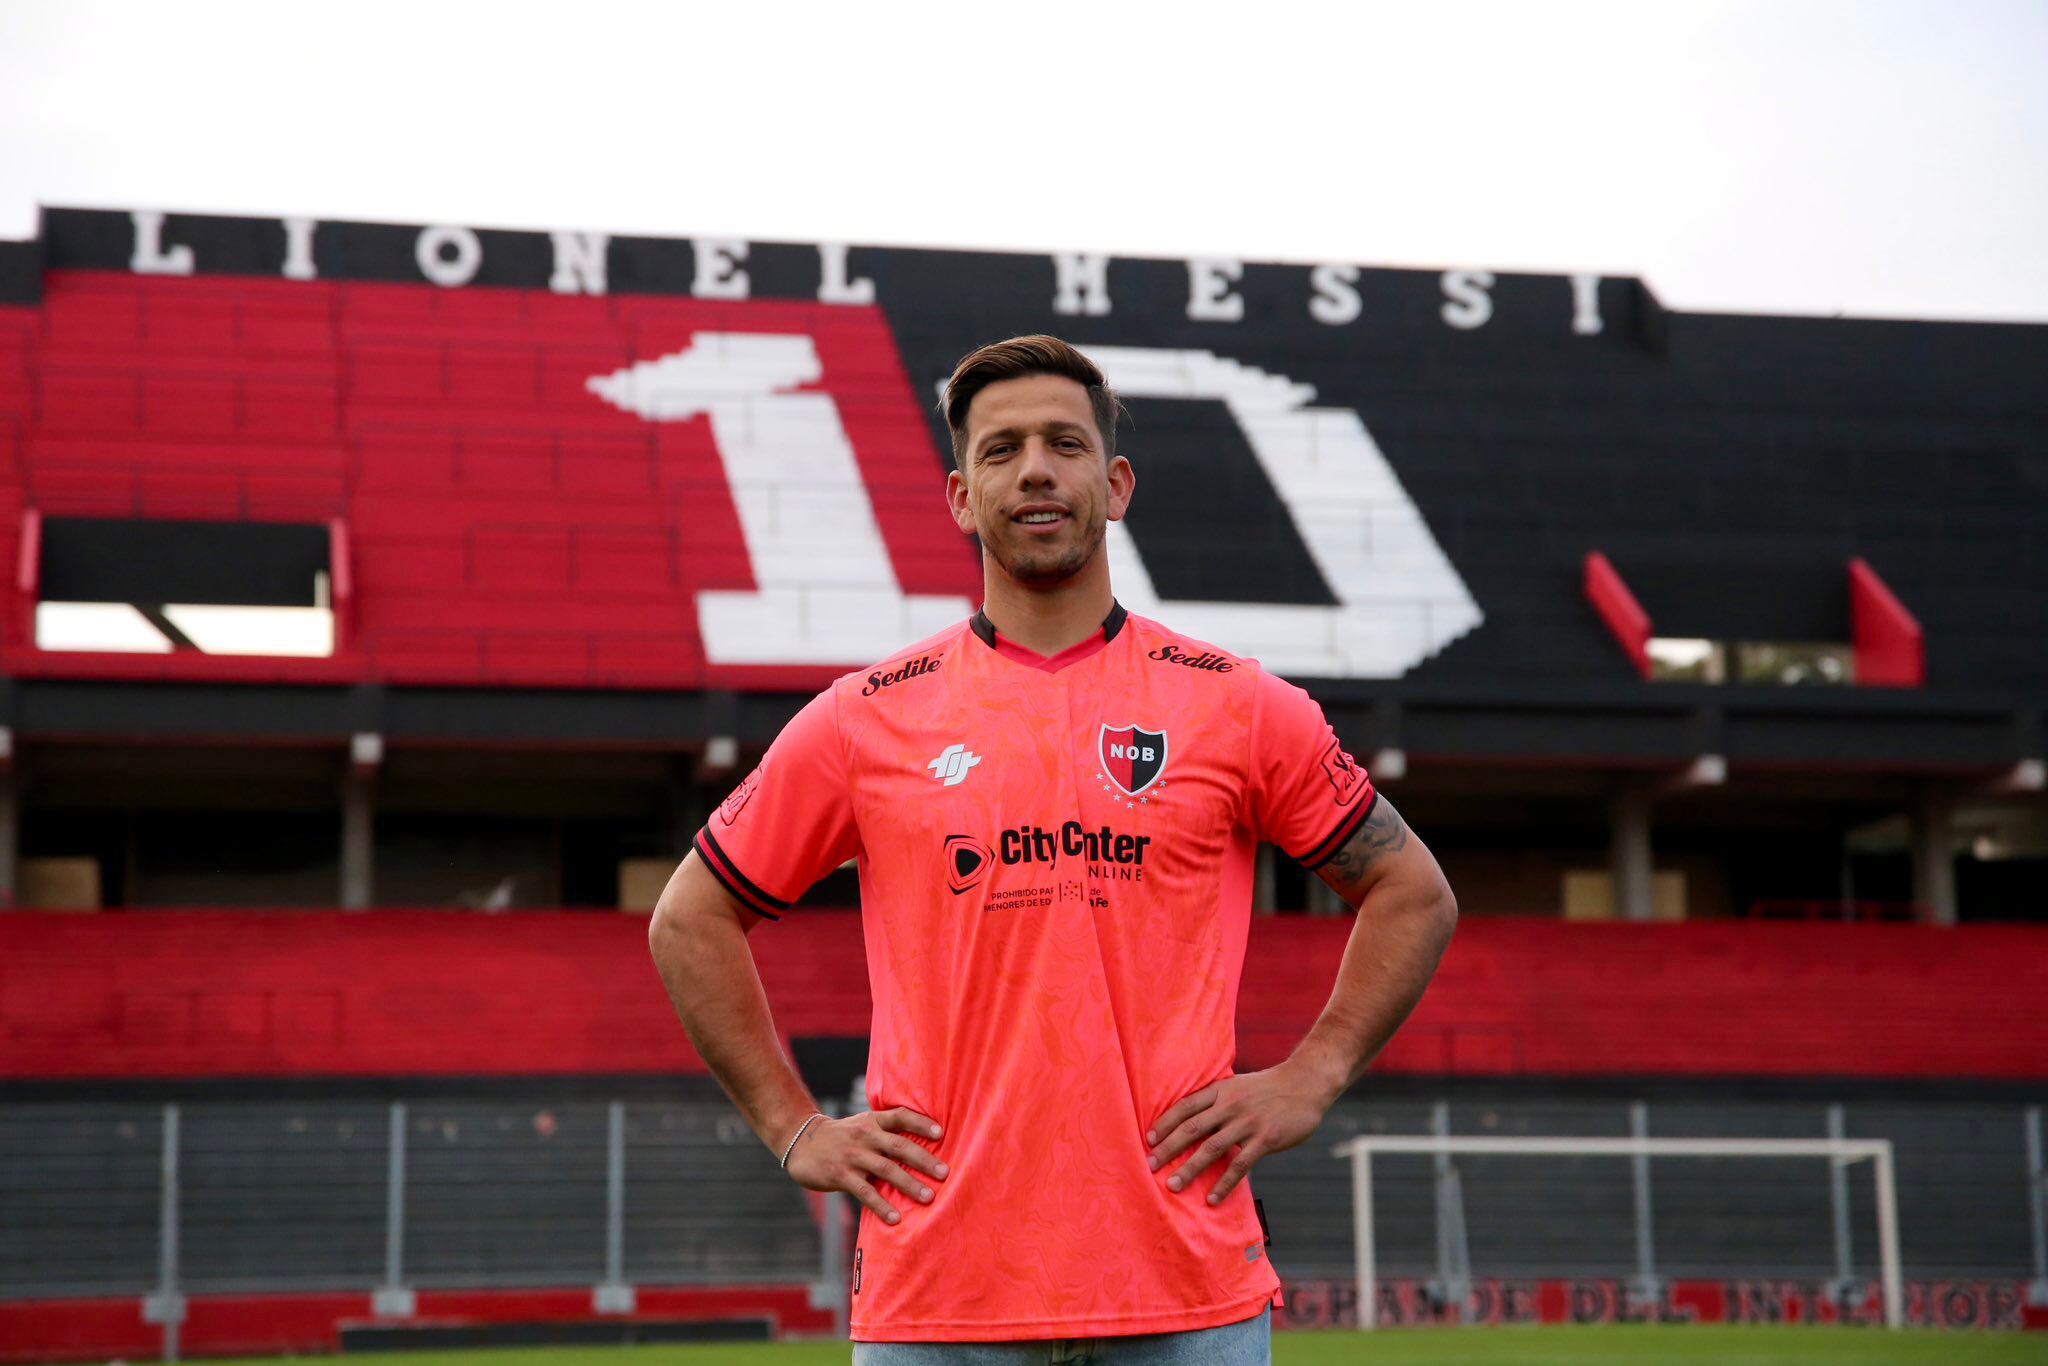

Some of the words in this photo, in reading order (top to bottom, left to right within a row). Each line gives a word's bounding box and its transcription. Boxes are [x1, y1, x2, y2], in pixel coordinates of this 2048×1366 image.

[131, 213, 875, 304] LIONEL
[1110, 743, 1155, 762] NOB
[1088, 864, 1142, 882] NLINE
[991, 888, 1038, 900] PROHIBIDO
[983, 900, 1025, 912] MENORES
[1026, 899, 1038, 908] DE
